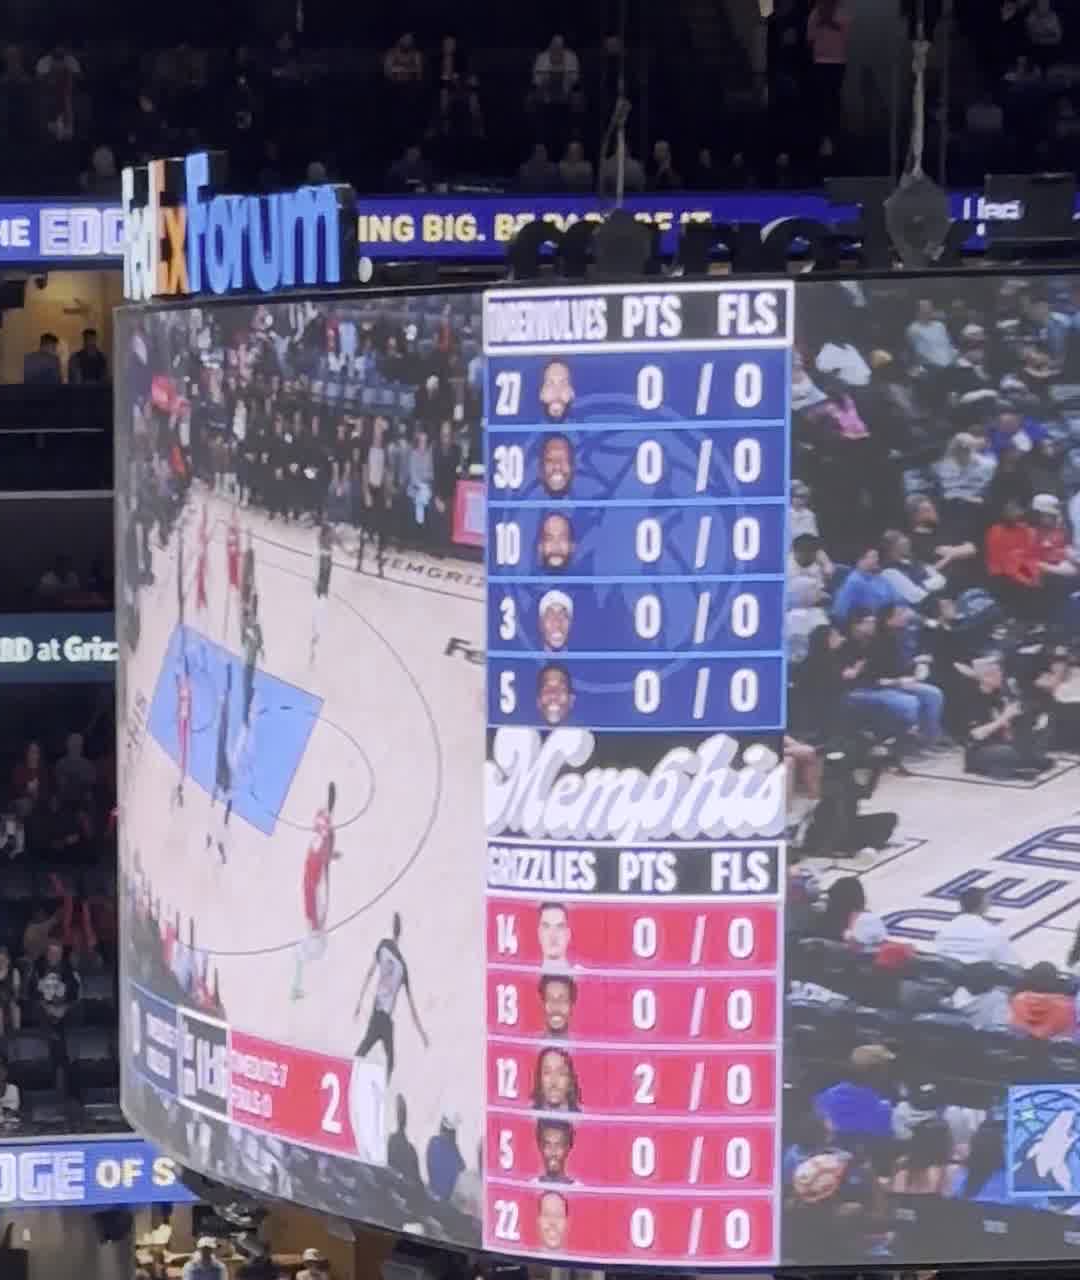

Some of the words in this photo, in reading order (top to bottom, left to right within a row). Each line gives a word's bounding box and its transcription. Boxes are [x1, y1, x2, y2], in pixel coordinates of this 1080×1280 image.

[422, 213, 486, 242] BIG.
[622, 294, 683, 339] PTS
[717, 291, 778, 337] FLS
[636, 364, 664, 411] 0
[733, 362, 763, 409] 0
[493, 445, 525, 489] 30
[636, 439, 663, 486] 0
[733, 438, 762, 484] 0
[495, 521, 521, 566] 10
[635, 517, 663, 564] 0
[732, 516, 761, 561] 0
[498, 596, 517, 641] 3
[634, 593, 662, 639] 0
[731, 592, 760, 639] 0
[36, 638, 62, 662] at
[498, 669, 517, 715] 5
[633, 668, 661, 714] 0
[728, 667, 759, 713] 0
[484, 726, 786, 843] Memphis
[617, 851, 678, 893] PTS
[710, 850, 770, 893] FLS
[631, 916, 657, 959] 0
[726, 917, 755, 959] 0
[631, 988, 657, 1030] 0
[725, 988, 753, 1031] 0
[320, 1071, 344, 1135] 2
[632, 1063, 656, 1105] 2
[725, 1063, 752, 1106] 0
[95, 1157, 144, 1190] OF
[498, 1129, 514, 1171] 5
[631, 1136, 656, 1178] 0
[725, 1137, 752, 1179] 0
[493, 1199, 521, 1241] 22
[629, 1207, 656, 1250] 0
[724, 1208, 751, 1250] 0
